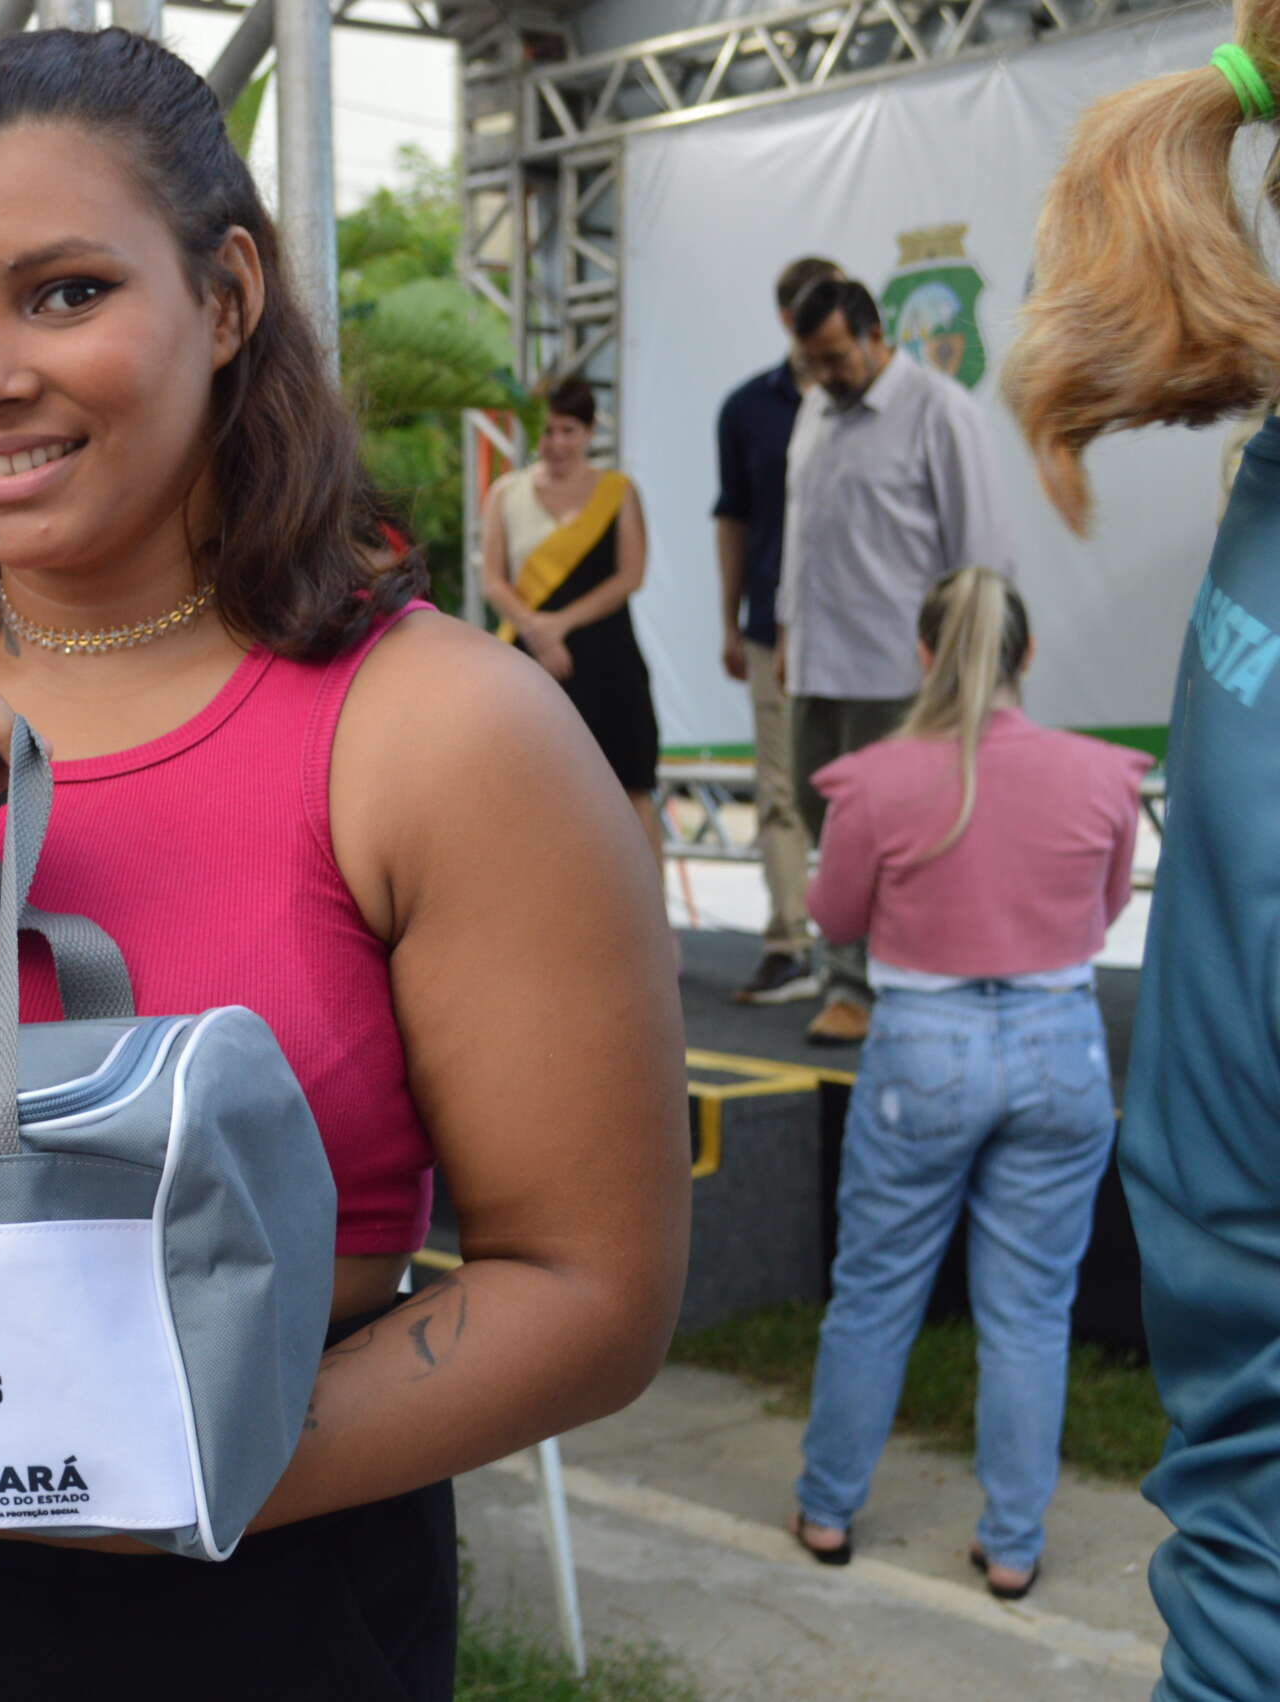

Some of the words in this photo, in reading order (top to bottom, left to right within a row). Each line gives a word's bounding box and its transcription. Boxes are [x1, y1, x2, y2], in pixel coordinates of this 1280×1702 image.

[13, 1496, 34, 1505] DO
[37, 1493, 90, 1504] ESTADO
[6, 1509, 49, 1518] PROTEÇÃO
